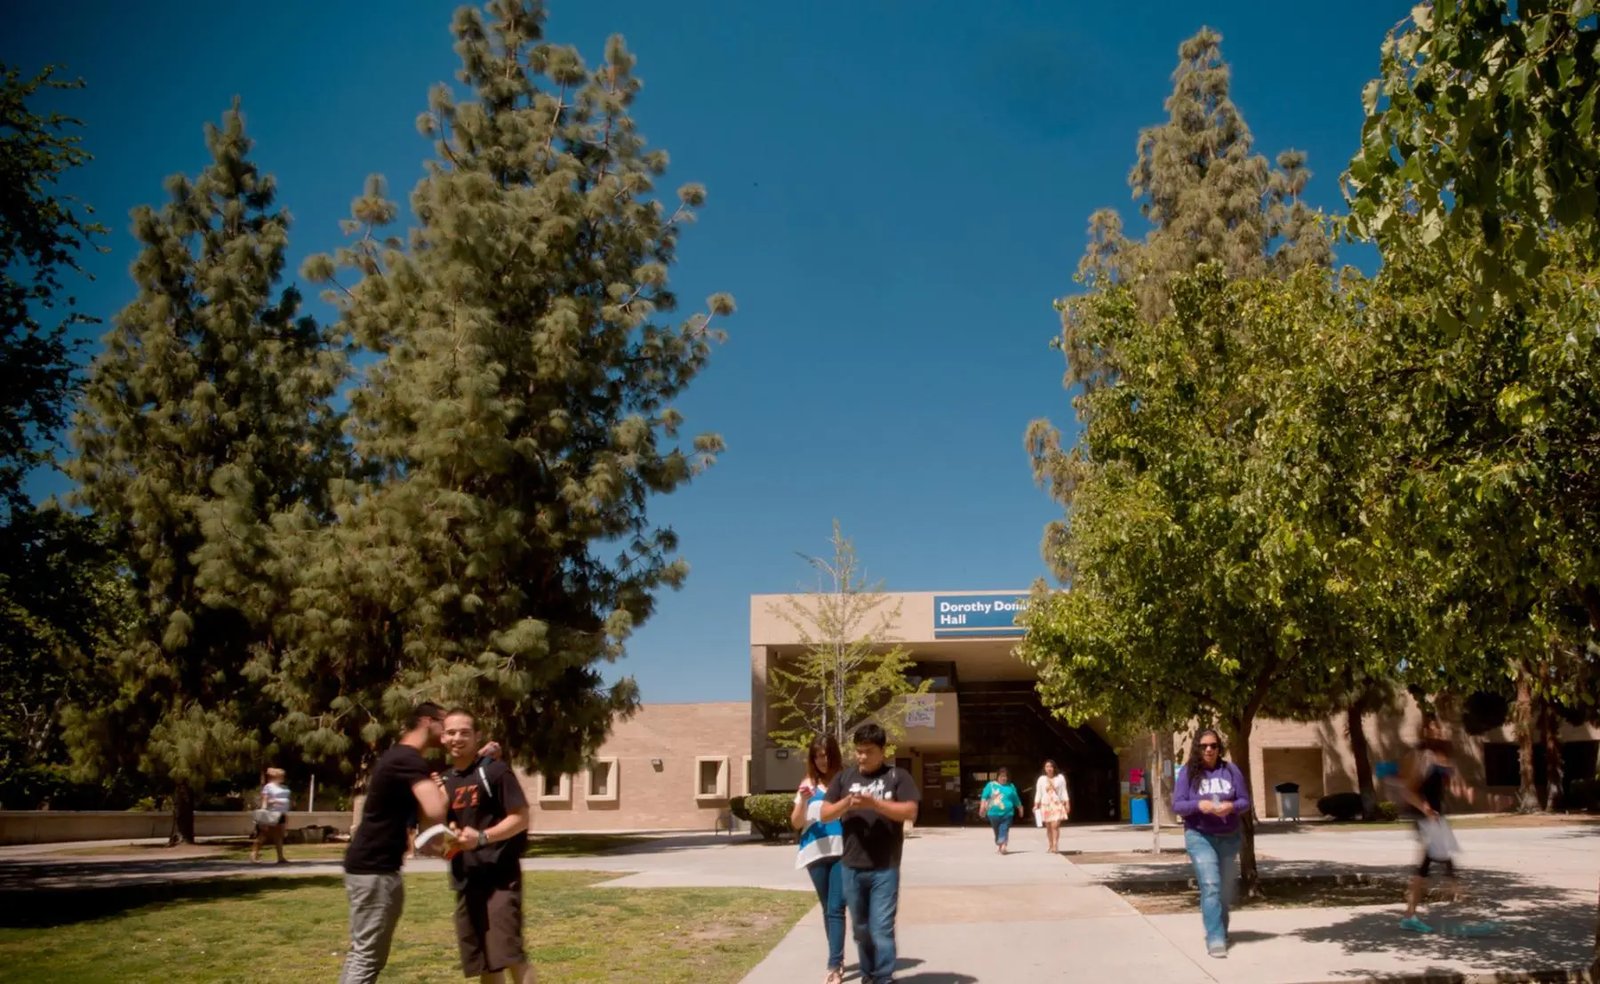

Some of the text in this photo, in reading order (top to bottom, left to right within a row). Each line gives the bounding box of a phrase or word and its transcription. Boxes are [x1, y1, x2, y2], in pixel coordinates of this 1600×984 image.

[940, 601, 991, 614] Dorothy
[940, 614, 966, 624] Hall
[1199, 777, 1231, 795] GAP
